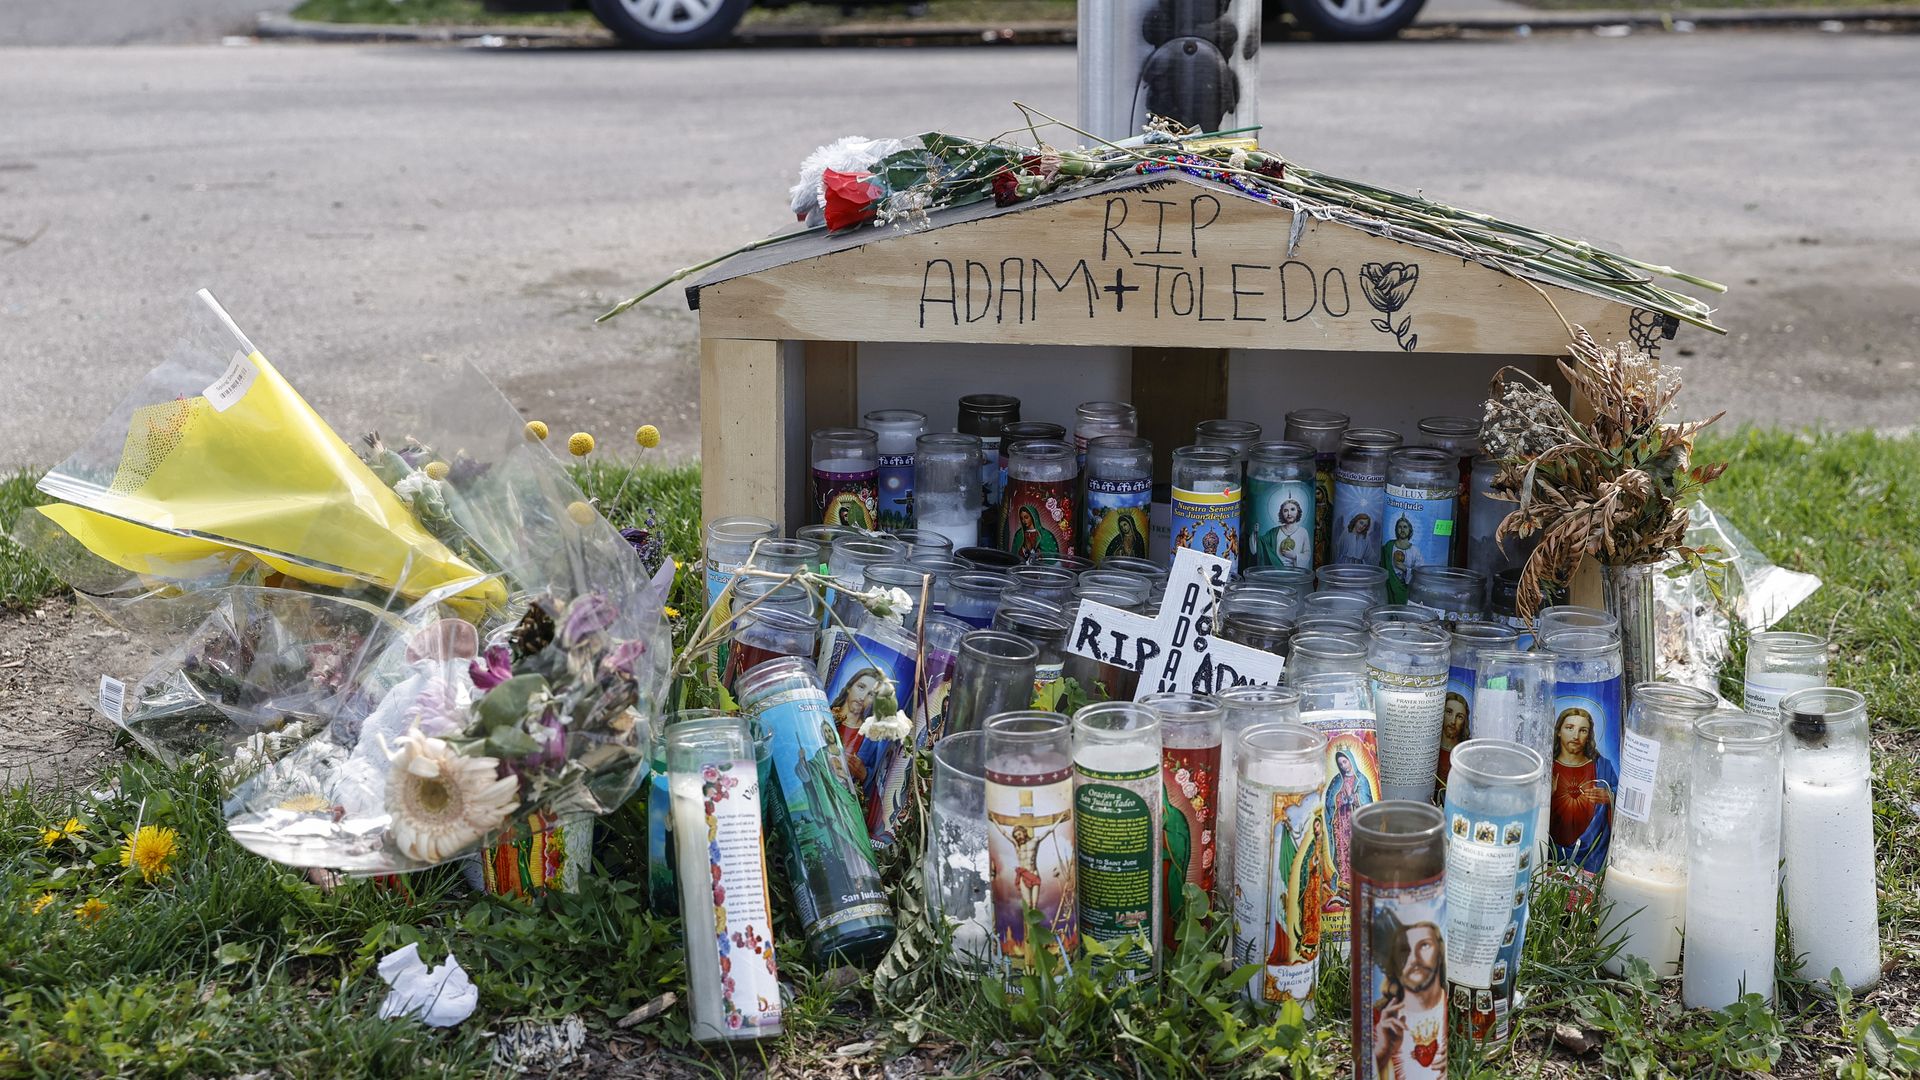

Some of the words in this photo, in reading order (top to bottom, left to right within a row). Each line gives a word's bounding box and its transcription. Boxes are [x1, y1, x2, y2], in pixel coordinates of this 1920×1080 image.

[1101, 195, 1221, 262] RIP
[1177, 502, 1206, 512] Nuestra
[1403, 501, 1424, 511] Jude
[1174, 509, 1185, 517] San
[1088, 788, 1115, 799] Oración
[1080, 794, 1091, 804] San
[1091, 797, 1112, 807] Judas
[1113, 798, 1136, 808] Tadeo
[841, 894, 860, 904] San
[860, 890, 882, 901] Judas
[1277, 968, 1303, 979] Virgen
[1004, 981, 1025, 995] Just
